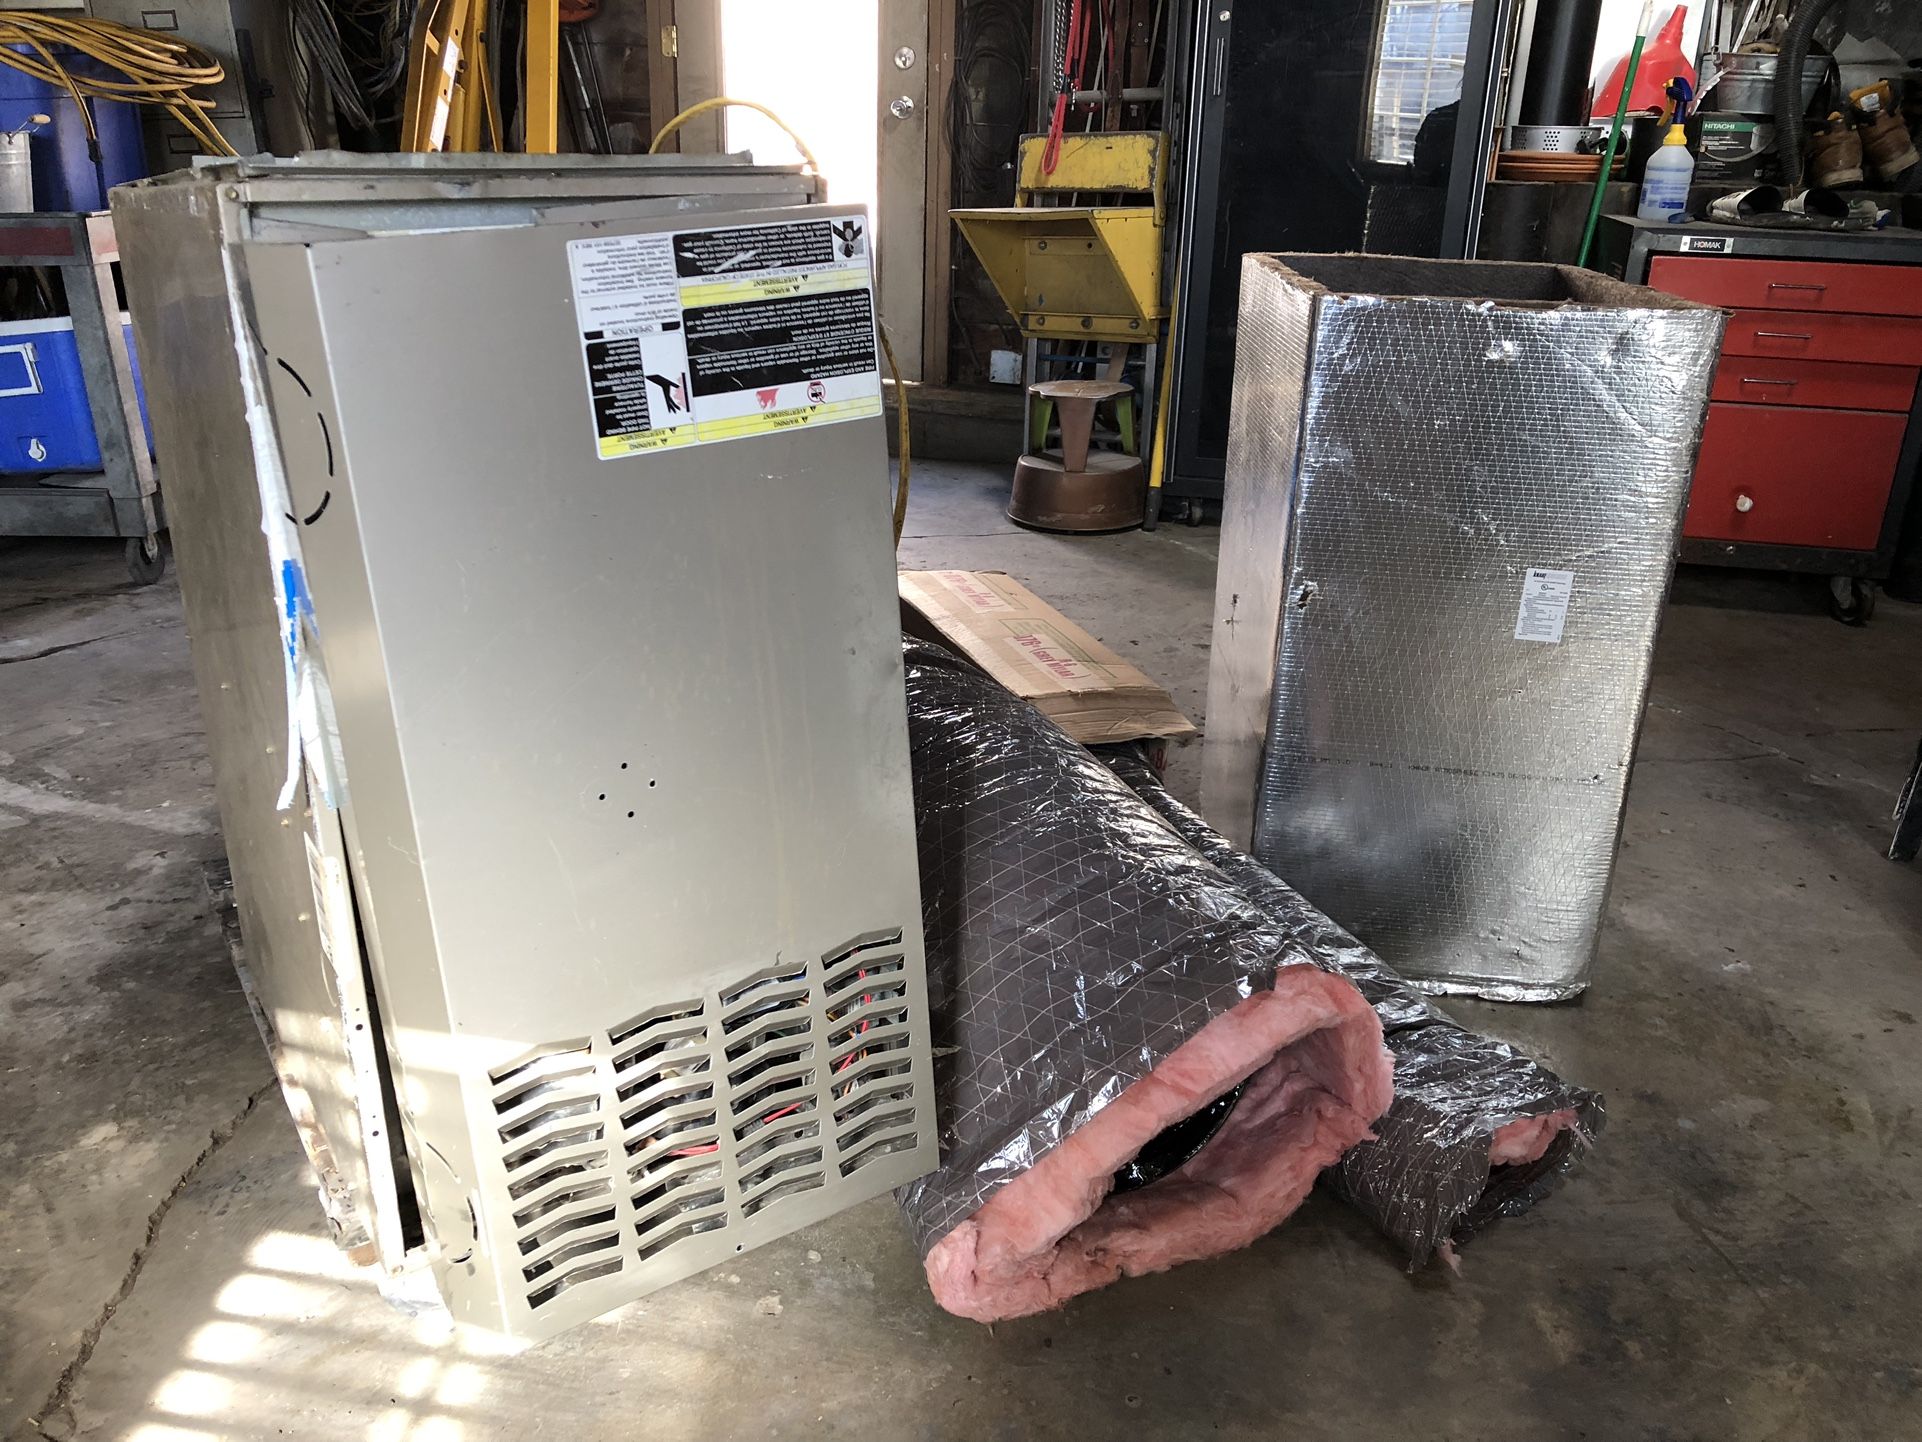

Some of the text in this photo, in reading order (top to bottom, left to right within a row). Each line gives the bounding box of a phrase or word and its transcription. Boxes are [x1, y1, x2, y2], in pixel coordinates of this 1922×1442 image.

[1704, 122, 1736, 130] HITACHI
[1693, 239, 1722, 250] HOMAK
[763, 287, 790, 295] WARNING
[773, 418, 799, 427] WARNING
[628, 440, 658, 450] WARNING
